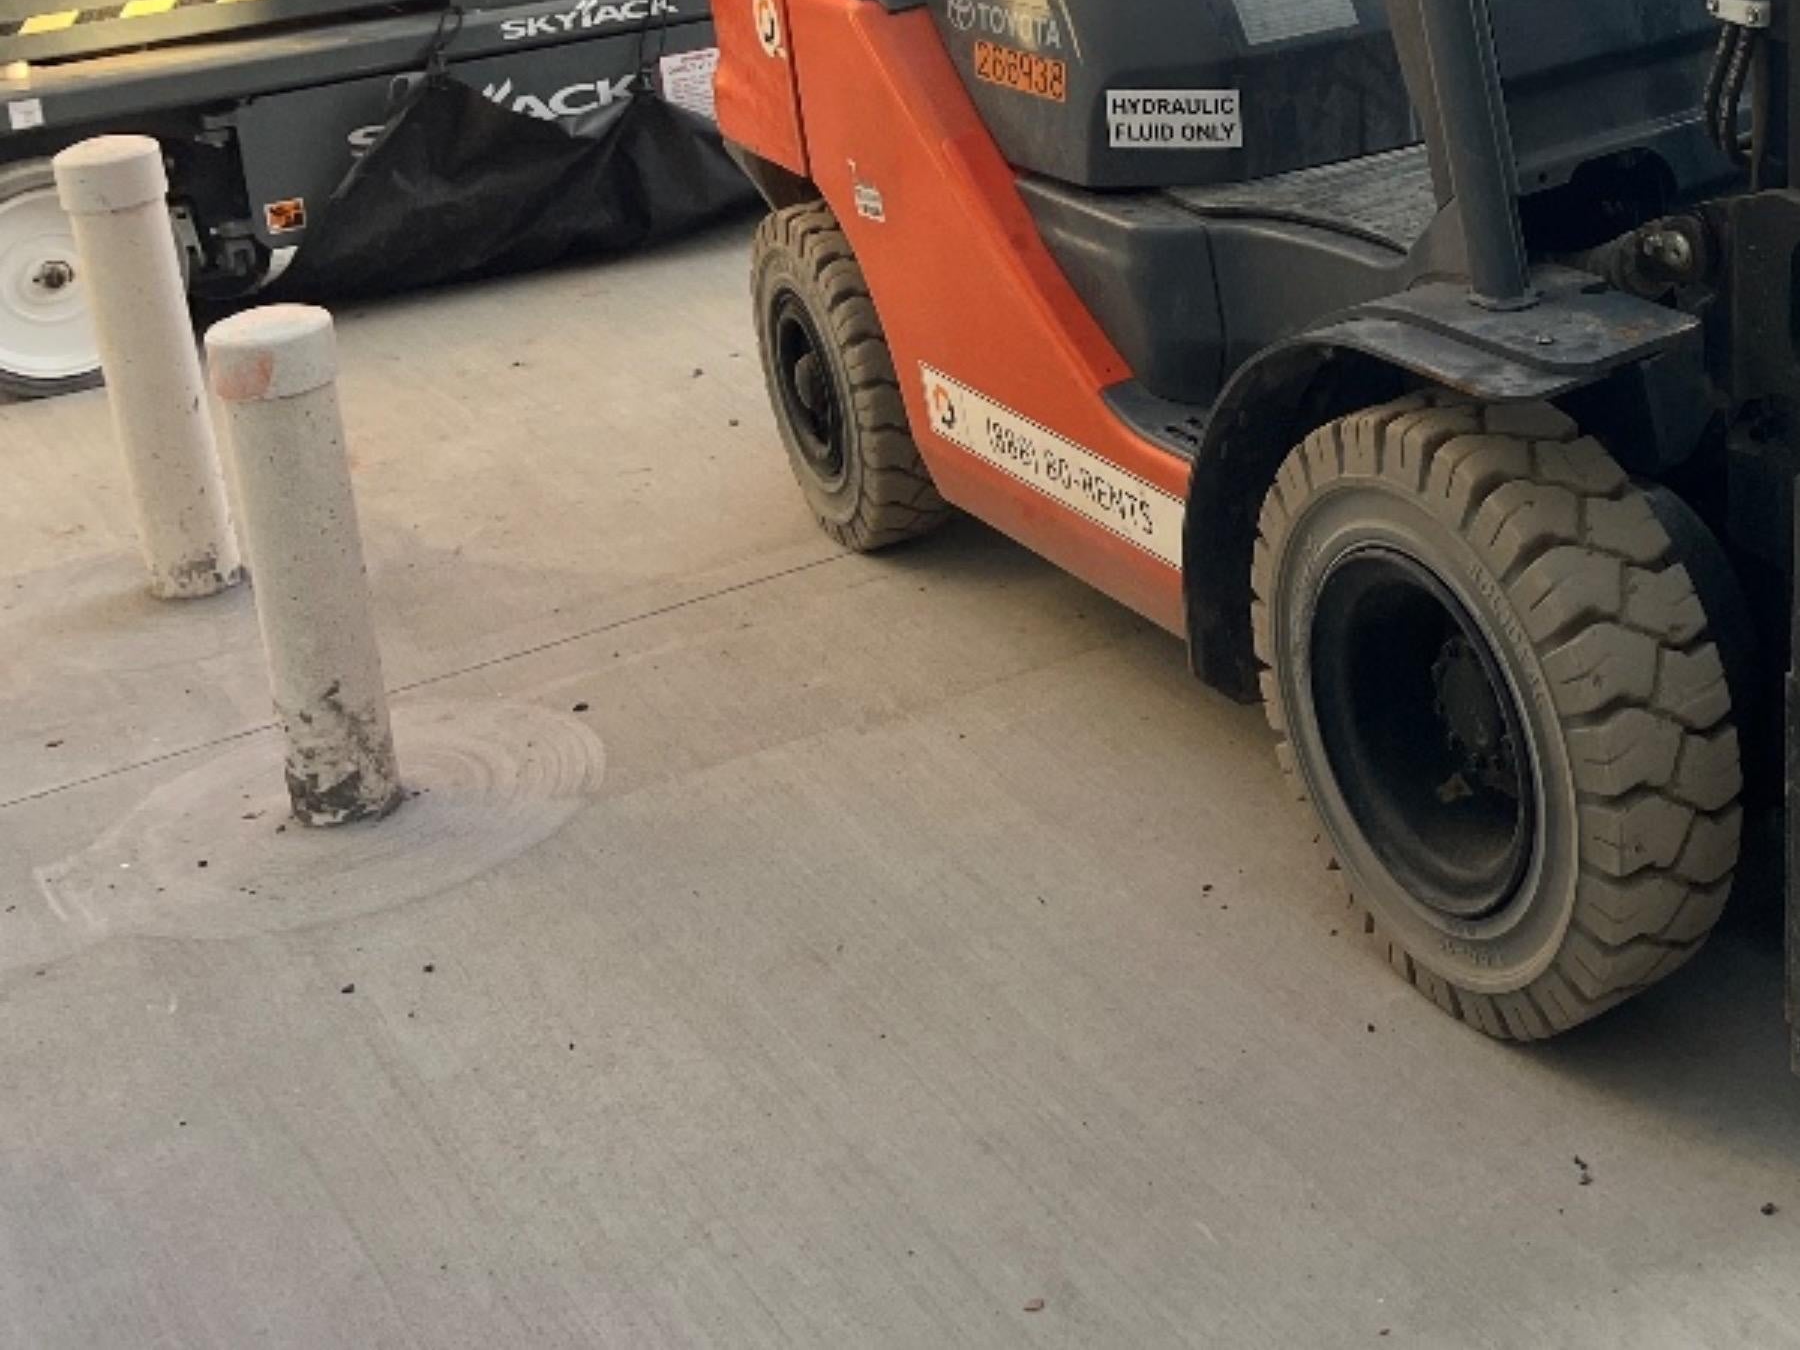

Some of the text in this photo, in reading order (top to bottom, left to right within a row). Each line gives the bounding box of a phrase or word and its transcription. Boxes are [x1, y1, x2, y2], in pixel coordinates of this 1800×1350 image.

[977, 4, 1062, 49] TOYOTA
[1112, 97, 1235, 115] HYDRAULIC
[1115, 121, 1237, 141] FLUID ONLY
